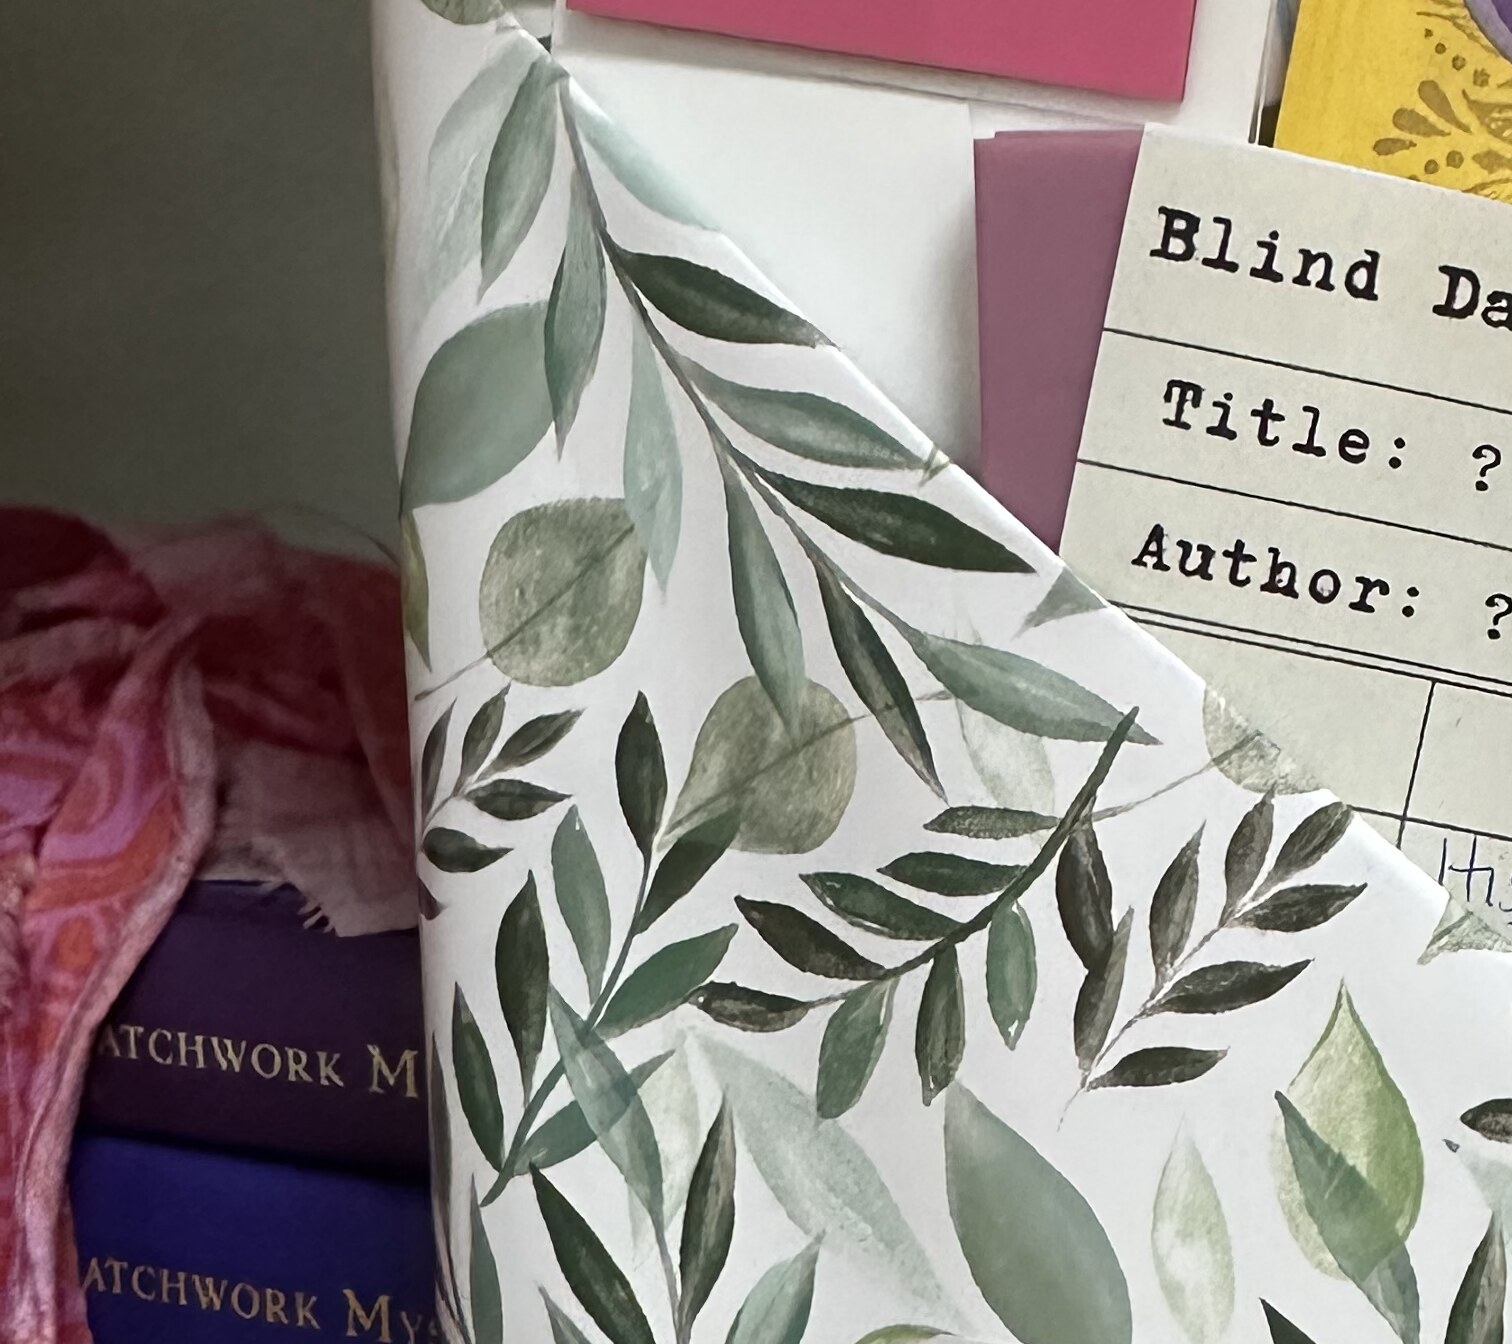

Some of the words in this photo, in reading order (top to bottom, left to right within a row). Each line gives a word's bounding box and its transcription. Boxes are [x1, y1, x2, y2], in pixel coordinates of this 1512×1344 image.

[1149, 205, 1382, 303] Blind
[1163, 378, 1407, 470] Title:
[1472, 443, 1503, 492] ?
[1131, 522, 1421, 618] Author:
[98, 1023, 345, 1088] ATCHWORK
[366, 1043, 420, 1098] M
[82, 1256, 321, 1330] ATCHWORK
